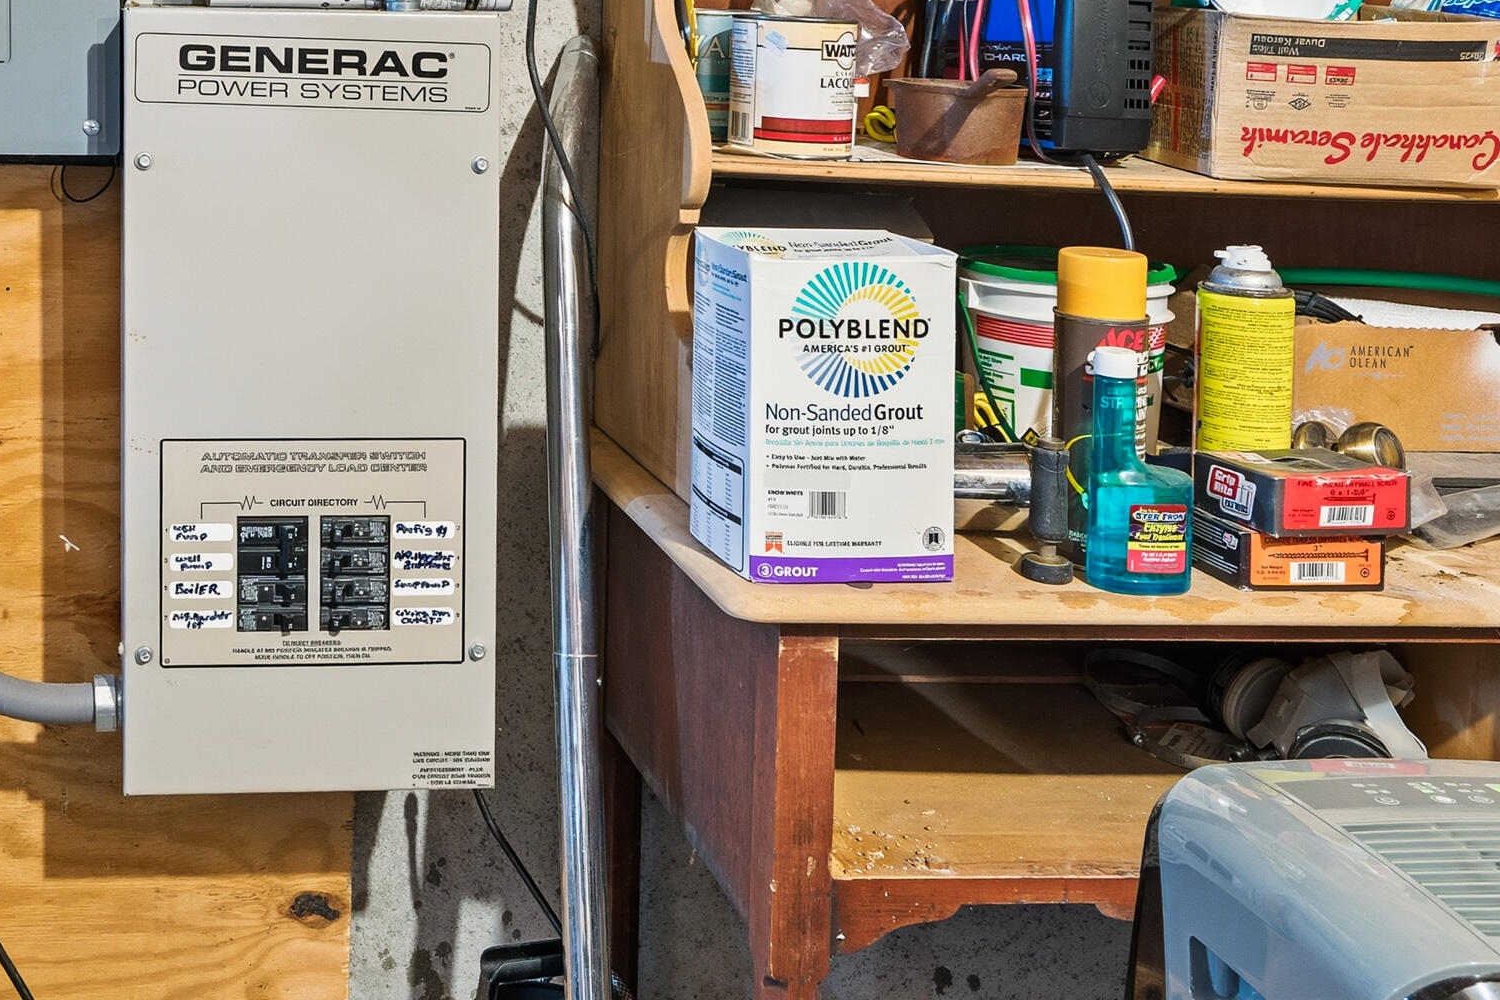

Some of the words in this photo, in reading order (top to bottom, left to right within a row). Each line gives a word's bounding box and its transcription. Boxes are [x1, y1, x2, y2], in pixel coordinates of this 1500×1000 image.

[1294, 37, 1326, 48] Duvar
[178, 44, 448, 78] GENERAC
[984, 53, 1041, 62] CHARG
[178, 79, 288, 98] POWER
[300, 82, 448, 103] SYSTEMS
[1241, 126, 1356, 166] Seramik
[1361, 130, 1500, 171] Çanakkale
[857, 237, 893, 248] Grout
[779, 319, 929, 339] POLYBLEND
[1097, 327, 1146, 351] ACE
[803, 344, 859, 353] AMERICA'S
[861, 345, 872, 353] #1
[874, 344, 907, 353] GROUT
[1350, 346, 1410, 358] AMERICAN
[1350, 357, 1387, 369] OLEAN
[765, 403, 872, 422] Non-Sanded
[874, 404, 923, 420] Grout
[765, 424, 780, 434] for
[782, 426, 810, 436] grout
[812, 425, 841, 436] joints
[843, 427, 856, 436] up
[858, 426, 868, 434] to
[871, 425, 895, 435] 1/8"
[201, 452, 287, 461] AUTOMATIC
[290, 452, 367, 461] TRANSFER
[369, 451, 426, 461] SWITCH
[200, 464, 233, 473] AND
[235, 463, 326, 473] EMERGENCY
[328, 463, 368, 473] LOAD
[370, 463, 428, 473] CENTER
[1214, 469, 1236, 487] Grip
[270, 499, 305, 507] CIRCUIT
[308, 498, 358, 507] DIRECTORY
[774, 566, 818, 578] GROUT
